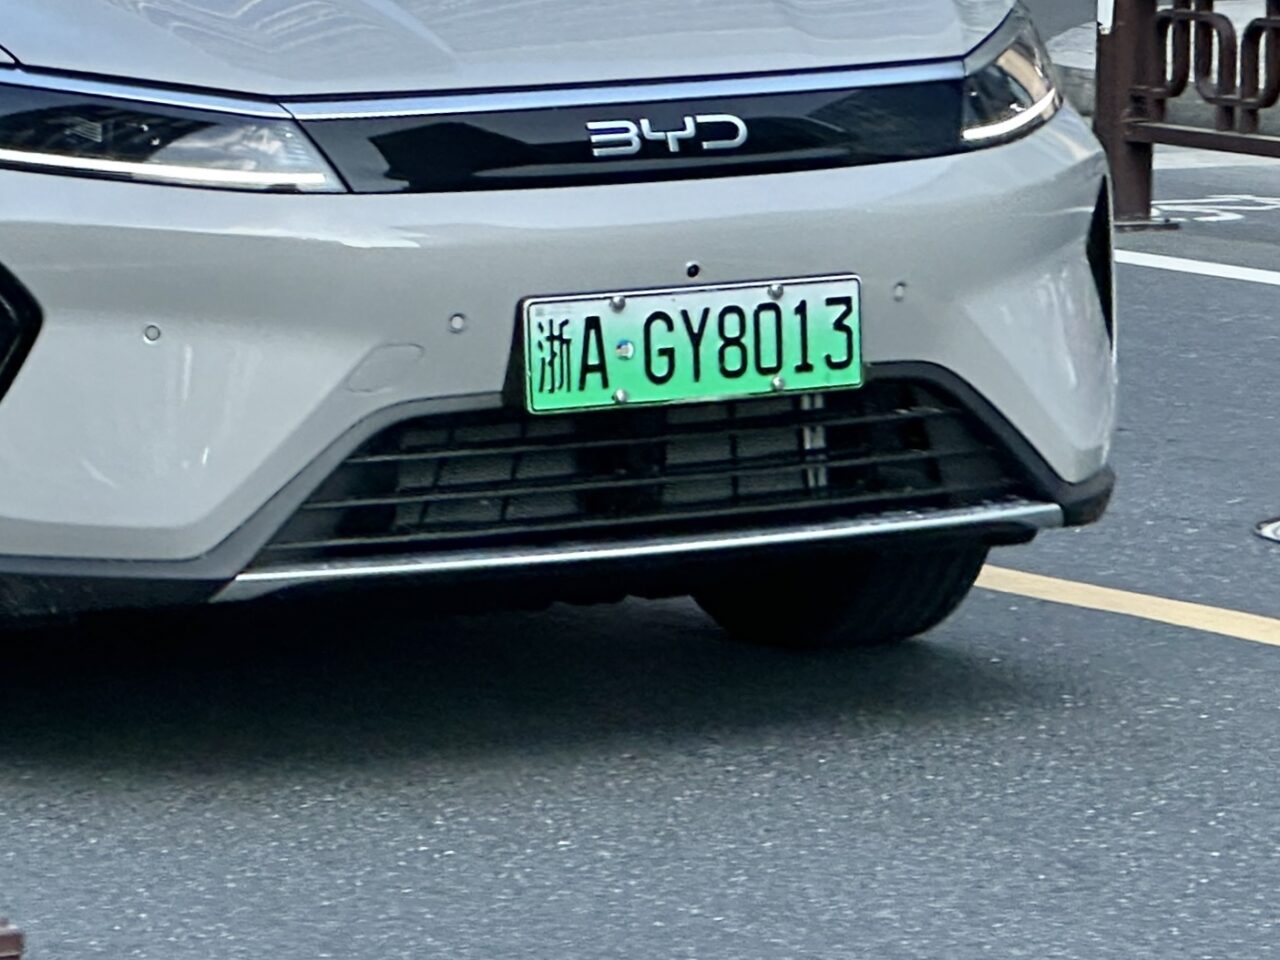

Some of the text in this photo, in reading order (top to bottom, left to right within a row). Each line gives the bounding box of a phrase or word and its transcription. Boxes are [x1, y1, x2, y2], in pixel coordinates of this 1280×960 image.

[586, 114, 748, 157] BYD
[538, 296, 854, 394] 浙A GY8013
